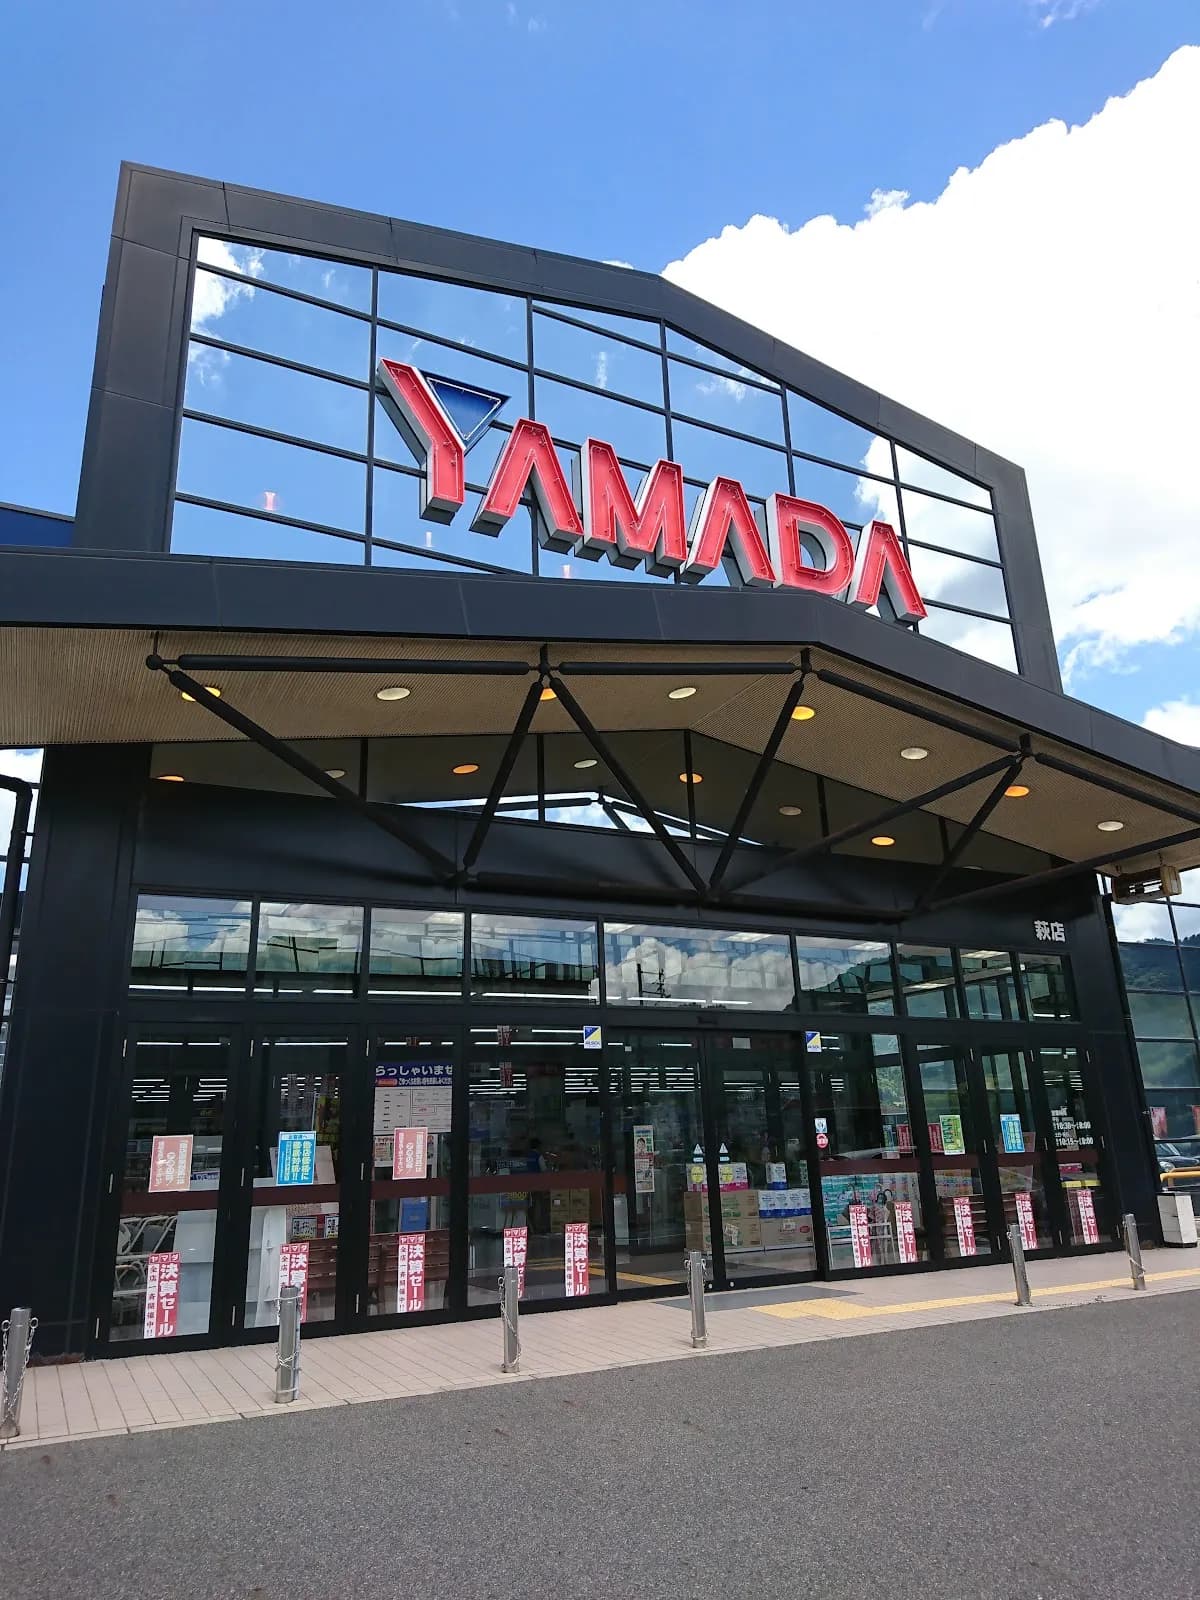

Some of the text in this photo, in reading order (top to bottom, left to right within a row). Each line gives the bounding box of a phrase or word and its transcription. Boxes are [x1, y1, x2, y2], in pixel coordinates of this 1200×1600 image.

[376, 357, 928, 622] YAMADA
[1034, 920, 1066, 942] 萩店
[151, 1253, 180, 1263] ヤマダ
[408, 1244, 424, 1311] 決算セール
[574, 1232, 588, 1295] 決算セール
[158, 1262, 179, 1336] 決算セール
